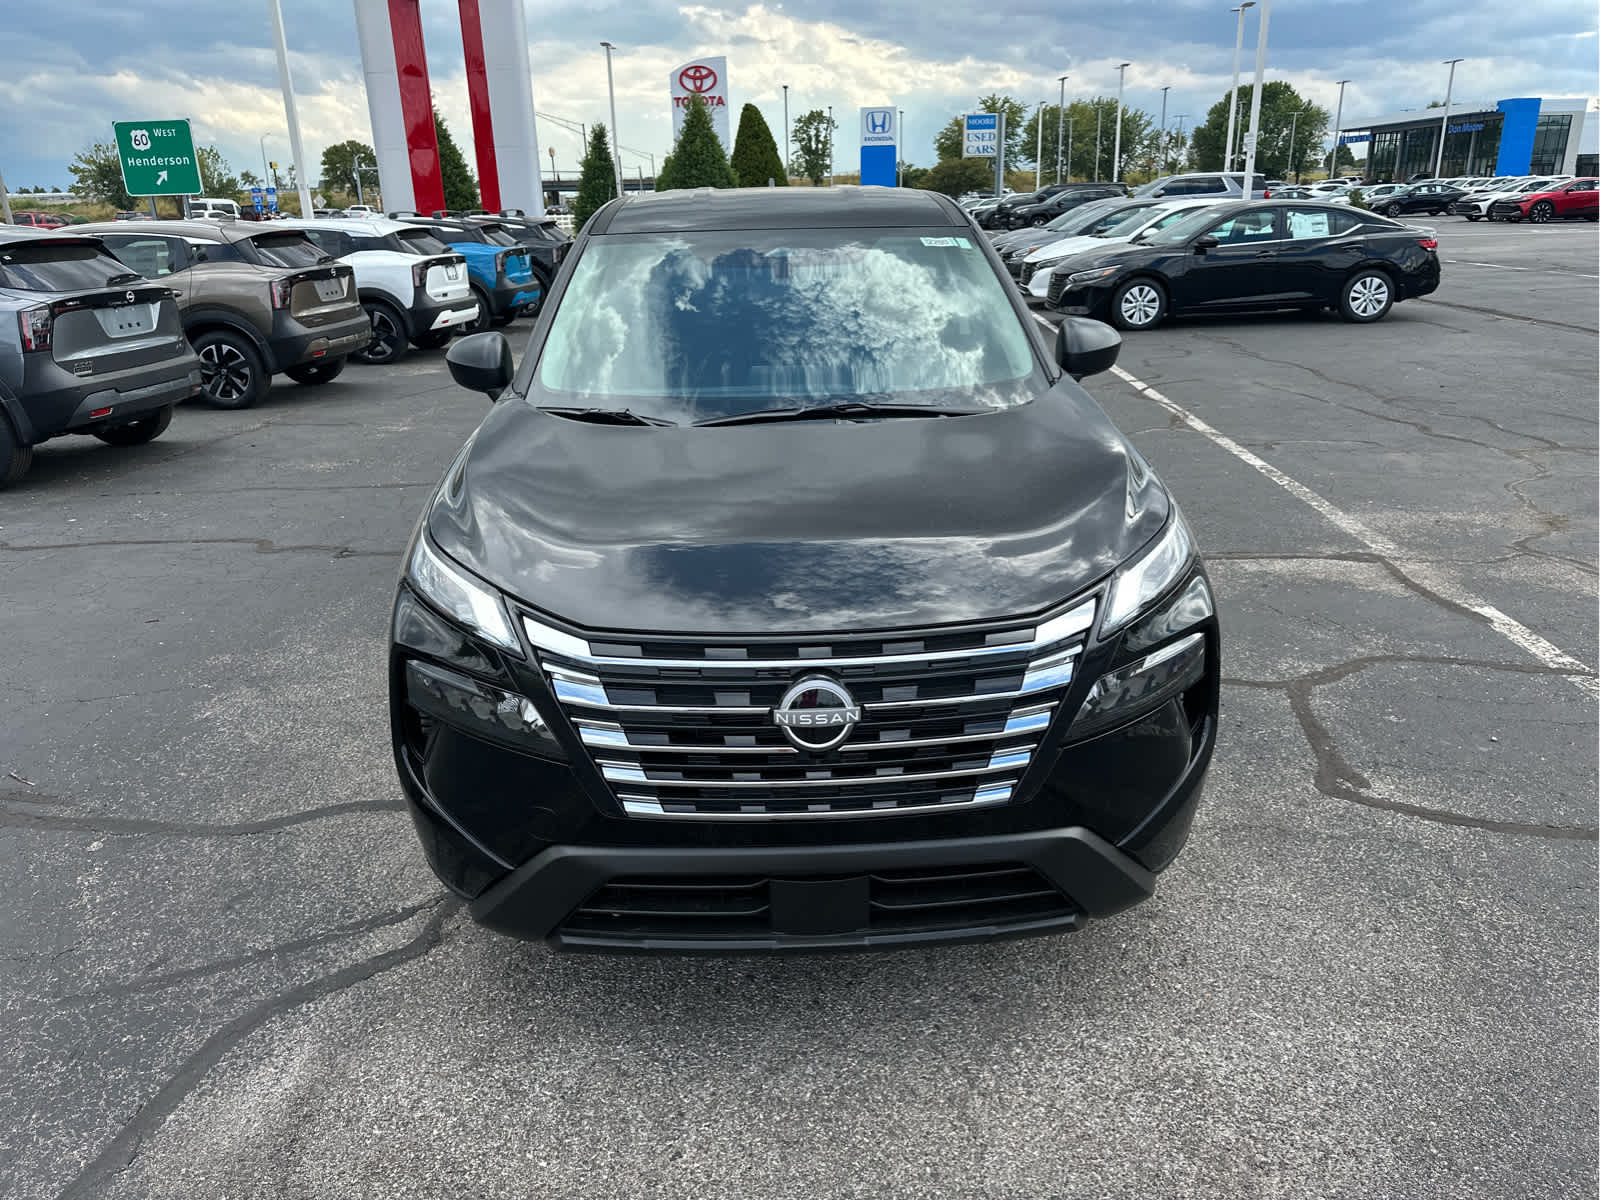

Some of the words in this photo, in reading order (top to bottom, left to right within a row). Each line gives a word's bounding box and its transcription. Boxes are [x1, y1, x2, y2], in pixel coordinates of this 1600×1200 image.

[673, 96, 726, 108] TOTA
[133, 134, 148, 146] 60
[153, 128, 176, 137] WEST
[967, 132, 996, 142] USED
[966, 144, 996, 155] CARS
[127, 156, 190, 167] Henderson
[775, 710, 859, 725] NISSAN
